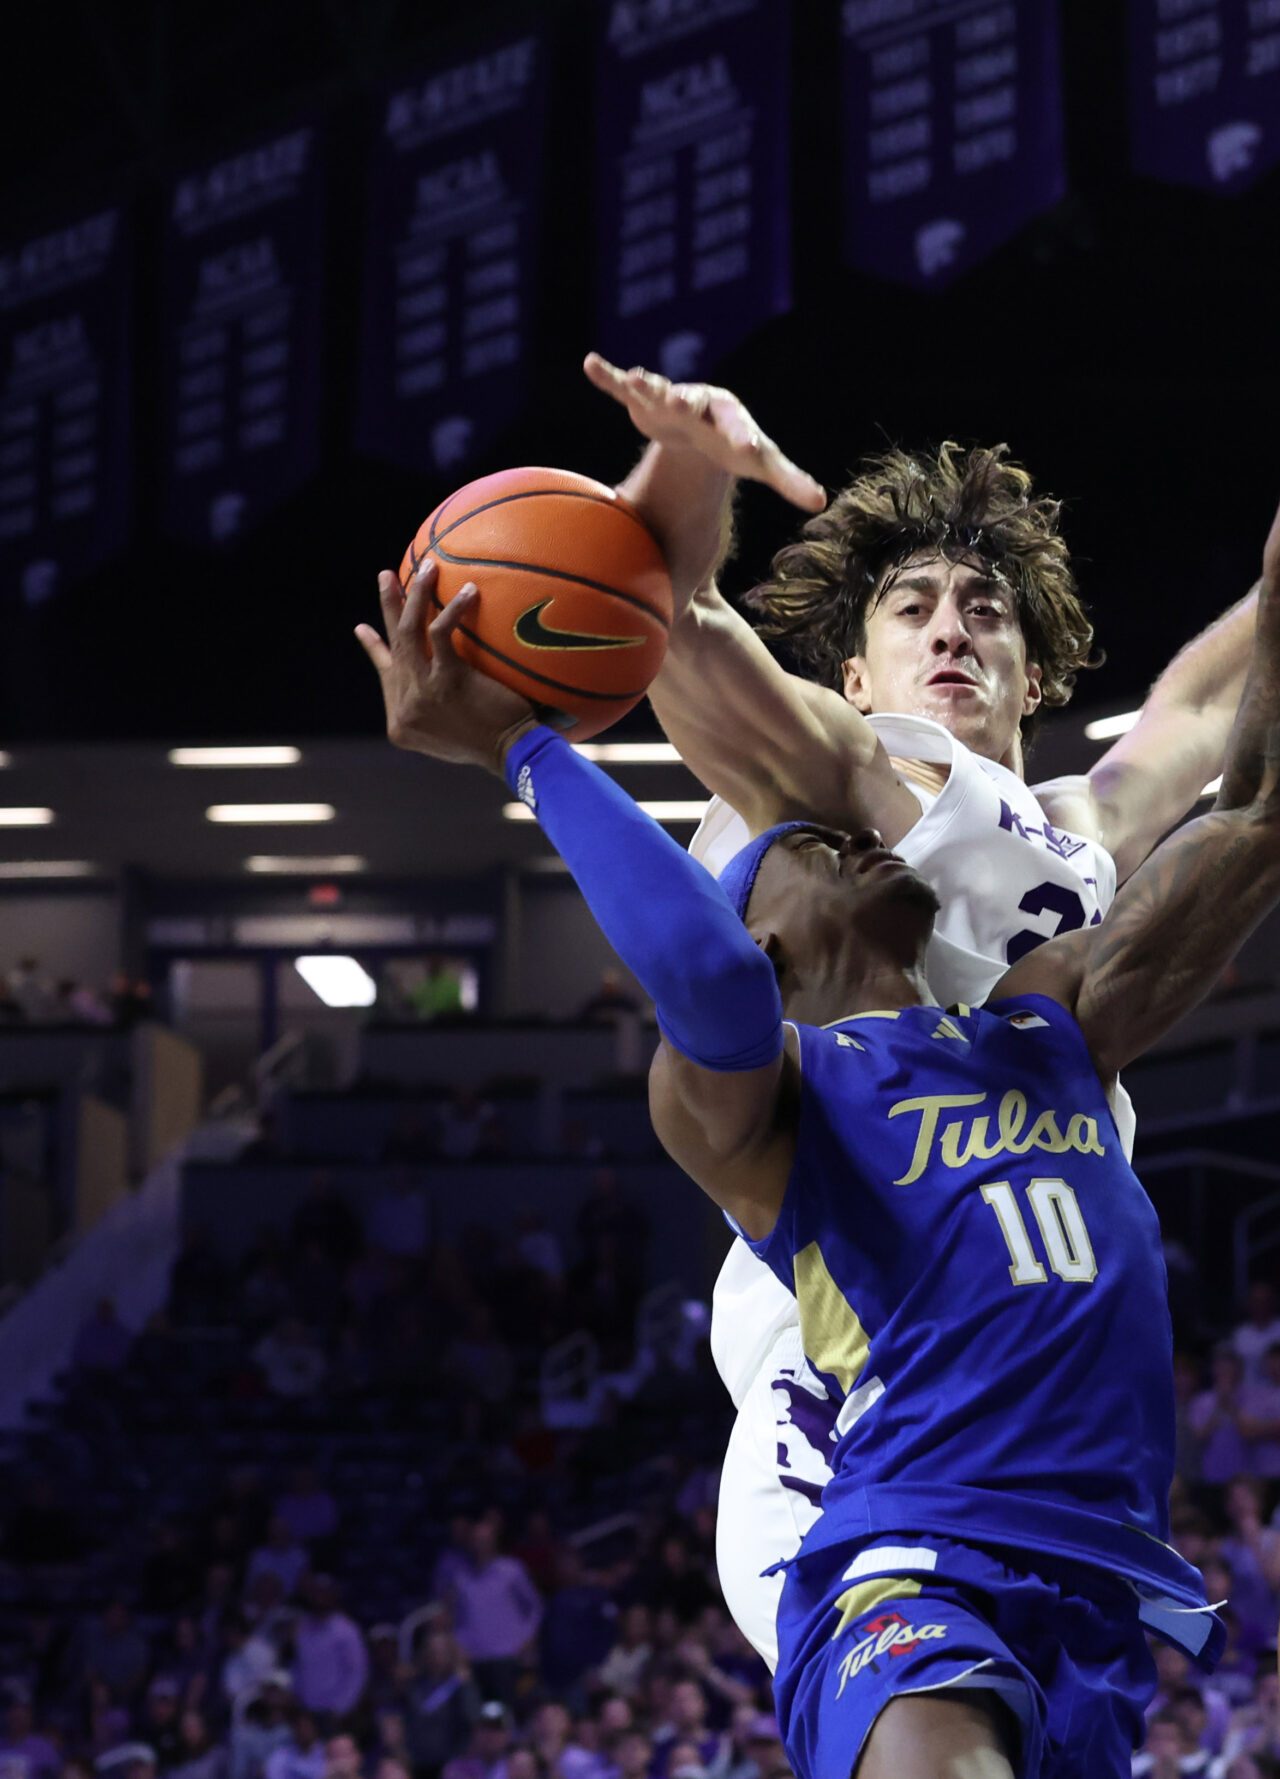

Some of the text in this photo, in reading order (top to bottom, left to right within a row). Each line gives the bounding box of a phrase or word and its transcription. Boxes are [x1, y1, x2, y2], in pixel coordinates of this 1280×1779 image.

[887, 1089, 1105, 1186] Tulsa
[979, 1177, 1099, 1286] 10
[835, 1622, 948, 1700] Tulsa
